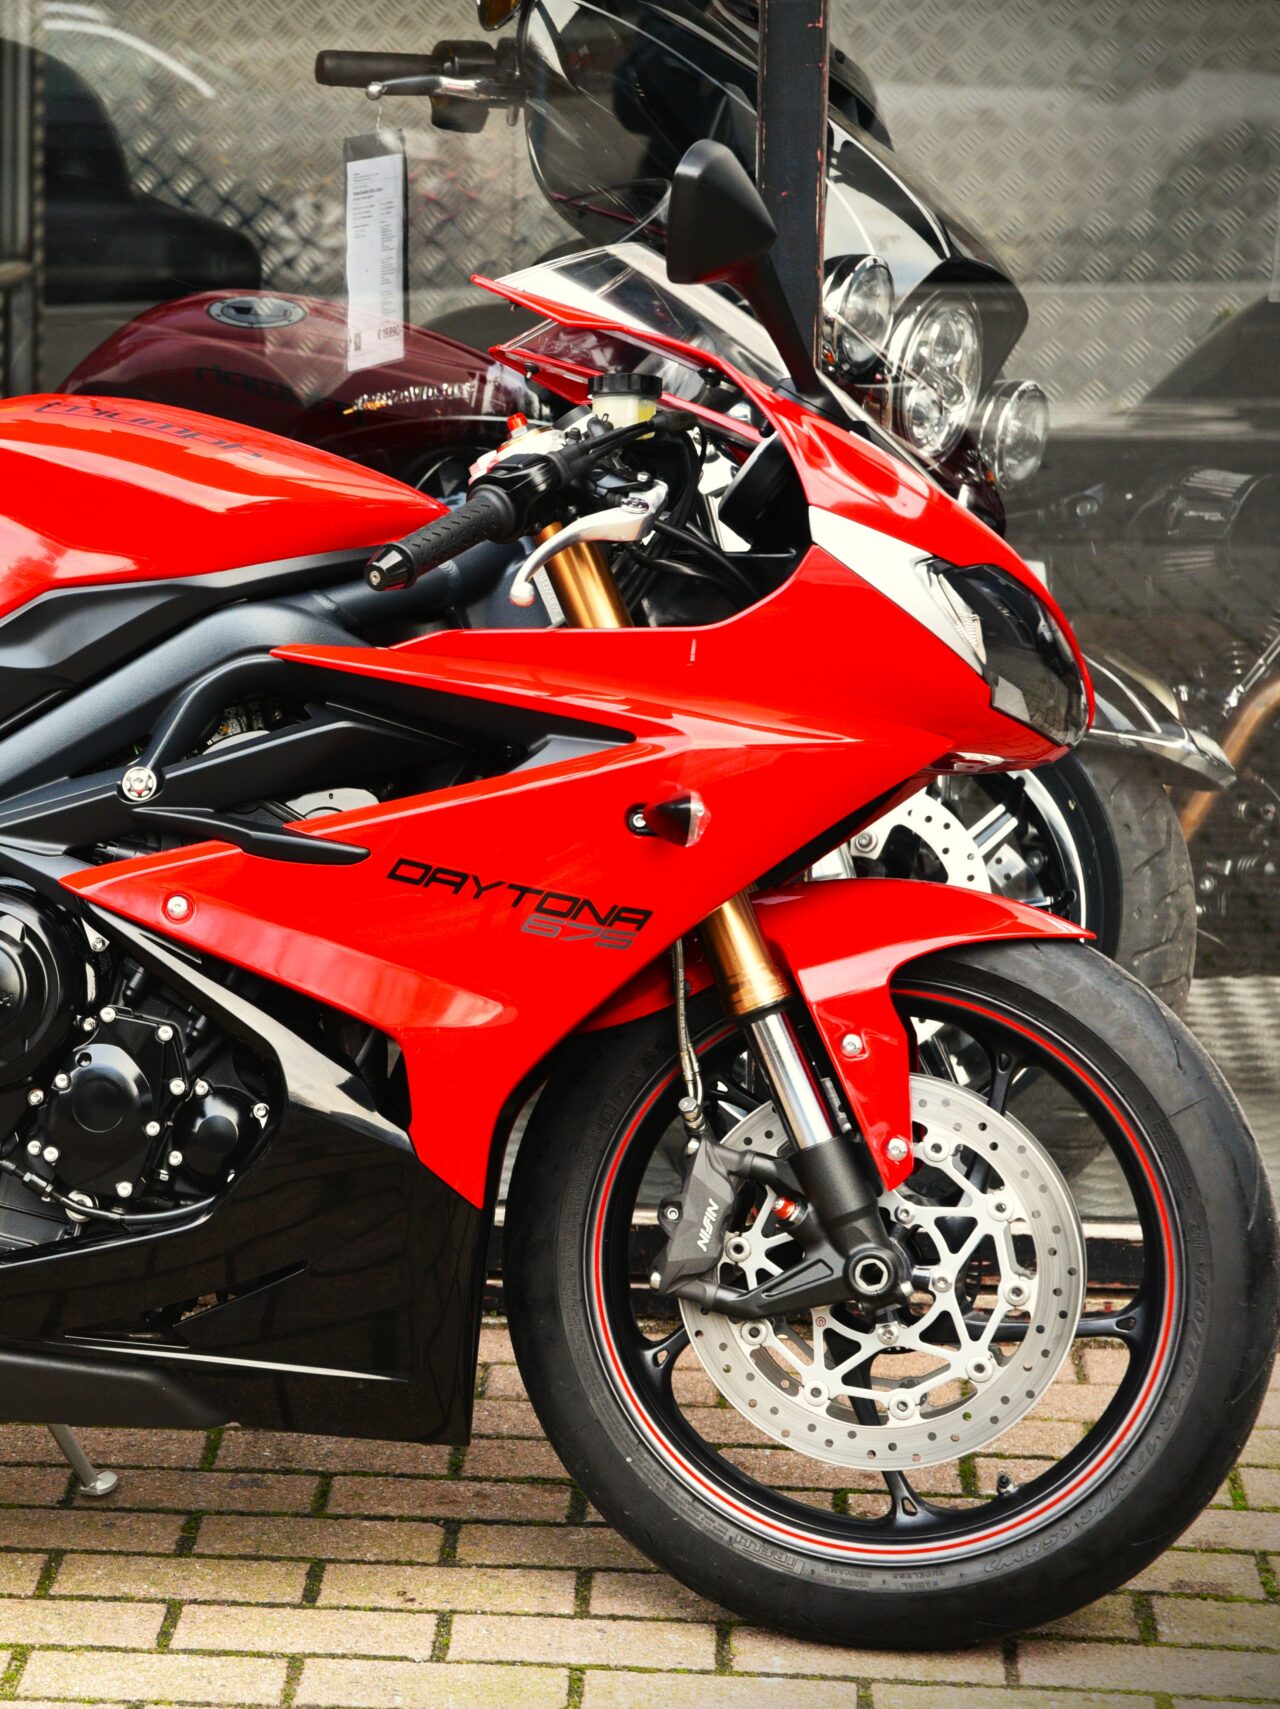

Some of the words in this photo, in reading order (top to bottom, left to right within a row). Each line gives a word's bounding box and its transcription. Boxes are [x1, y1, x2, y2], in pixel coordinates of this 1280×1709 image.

[386, 857, 653, 931] DAYTONA
[521, 914, 637, 951] 675
[730, 1533, 805, 1575] PIRELLI
